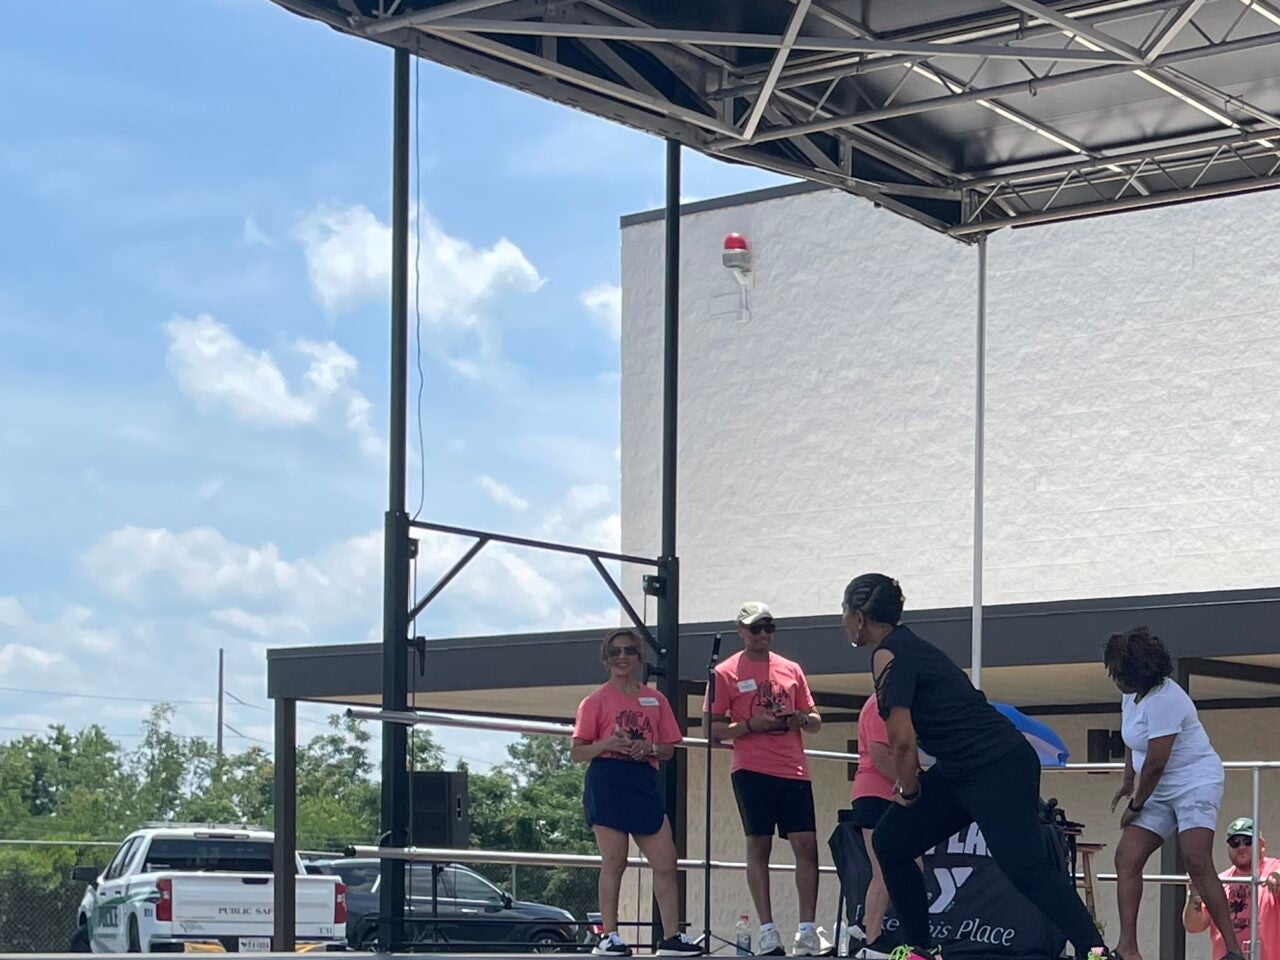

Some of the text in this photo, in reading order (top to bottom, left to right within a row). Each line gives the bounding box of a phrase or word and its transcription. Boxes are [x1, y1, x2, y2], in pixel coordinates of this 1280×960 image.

[218, 907, 273, 915] PUBLIC SAF
[954, 918, 1015, 946] Place
